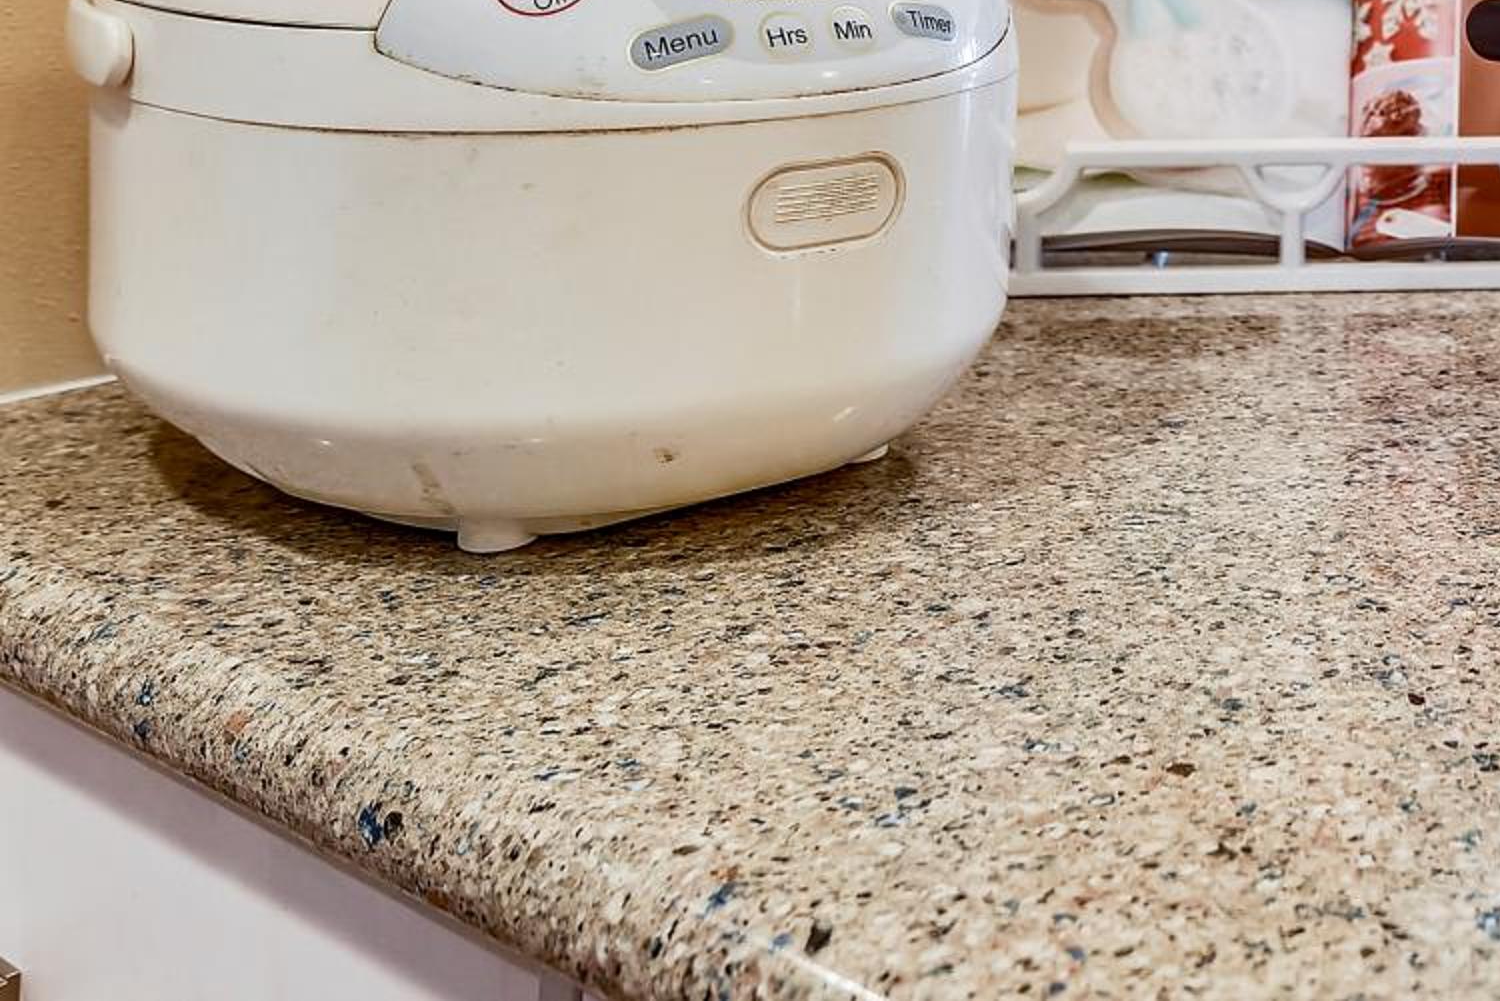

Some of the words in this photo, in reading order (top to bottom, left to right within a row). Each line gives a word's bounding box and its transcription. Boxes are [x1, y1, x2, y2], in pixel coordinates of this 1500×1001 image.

[833, 20, 873, 40] Min
[906, 10, 952, 34] Timer
[643, 28, 719, 61] Menu
[766, 27, 808, 48] Hrs
